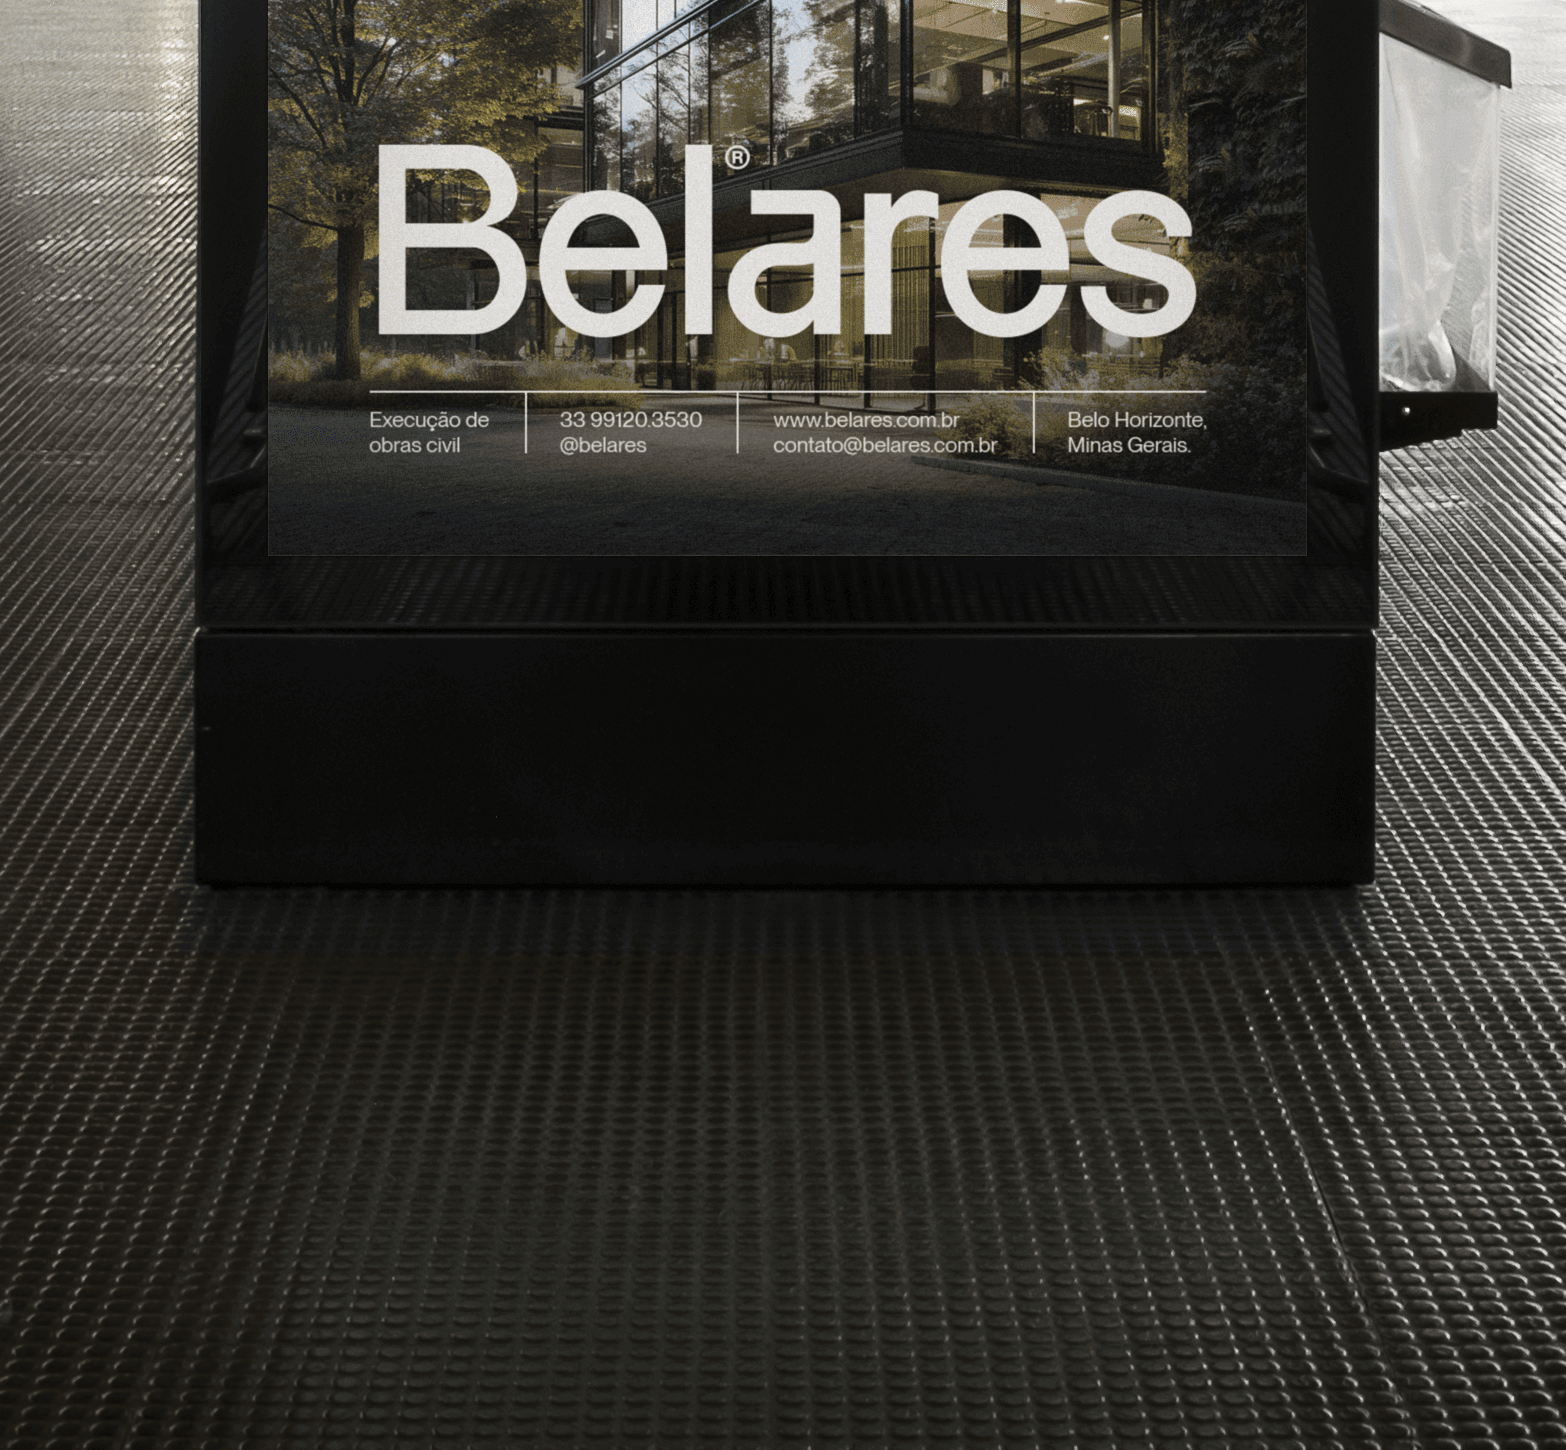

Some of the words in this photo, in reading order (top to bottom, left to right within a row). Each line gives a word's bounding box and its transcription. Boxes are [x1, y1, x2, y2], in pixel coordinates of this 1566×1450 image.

[370, 411, 461, 432] Execução
[466, 411, 490, 428] de
[560, 411, 586, 428] 33
[590, 411, 703, 428] 99120.3530
[773, 411, 961, 428] www.belares.com.br
[1068, 411, 1110, 428] Belo
[1115, 411, 1207, 431] Horizonte,
[369, 436, 422, 453] obras
[426, 436, 461, 453] civil
[559, 436, 647, 456] @belares
[773, 436, 998, 456] contato@belares.com.br
[1068, 436, 1123, 453] Minas
[1127, 436, 1191, 453] Gerais.
